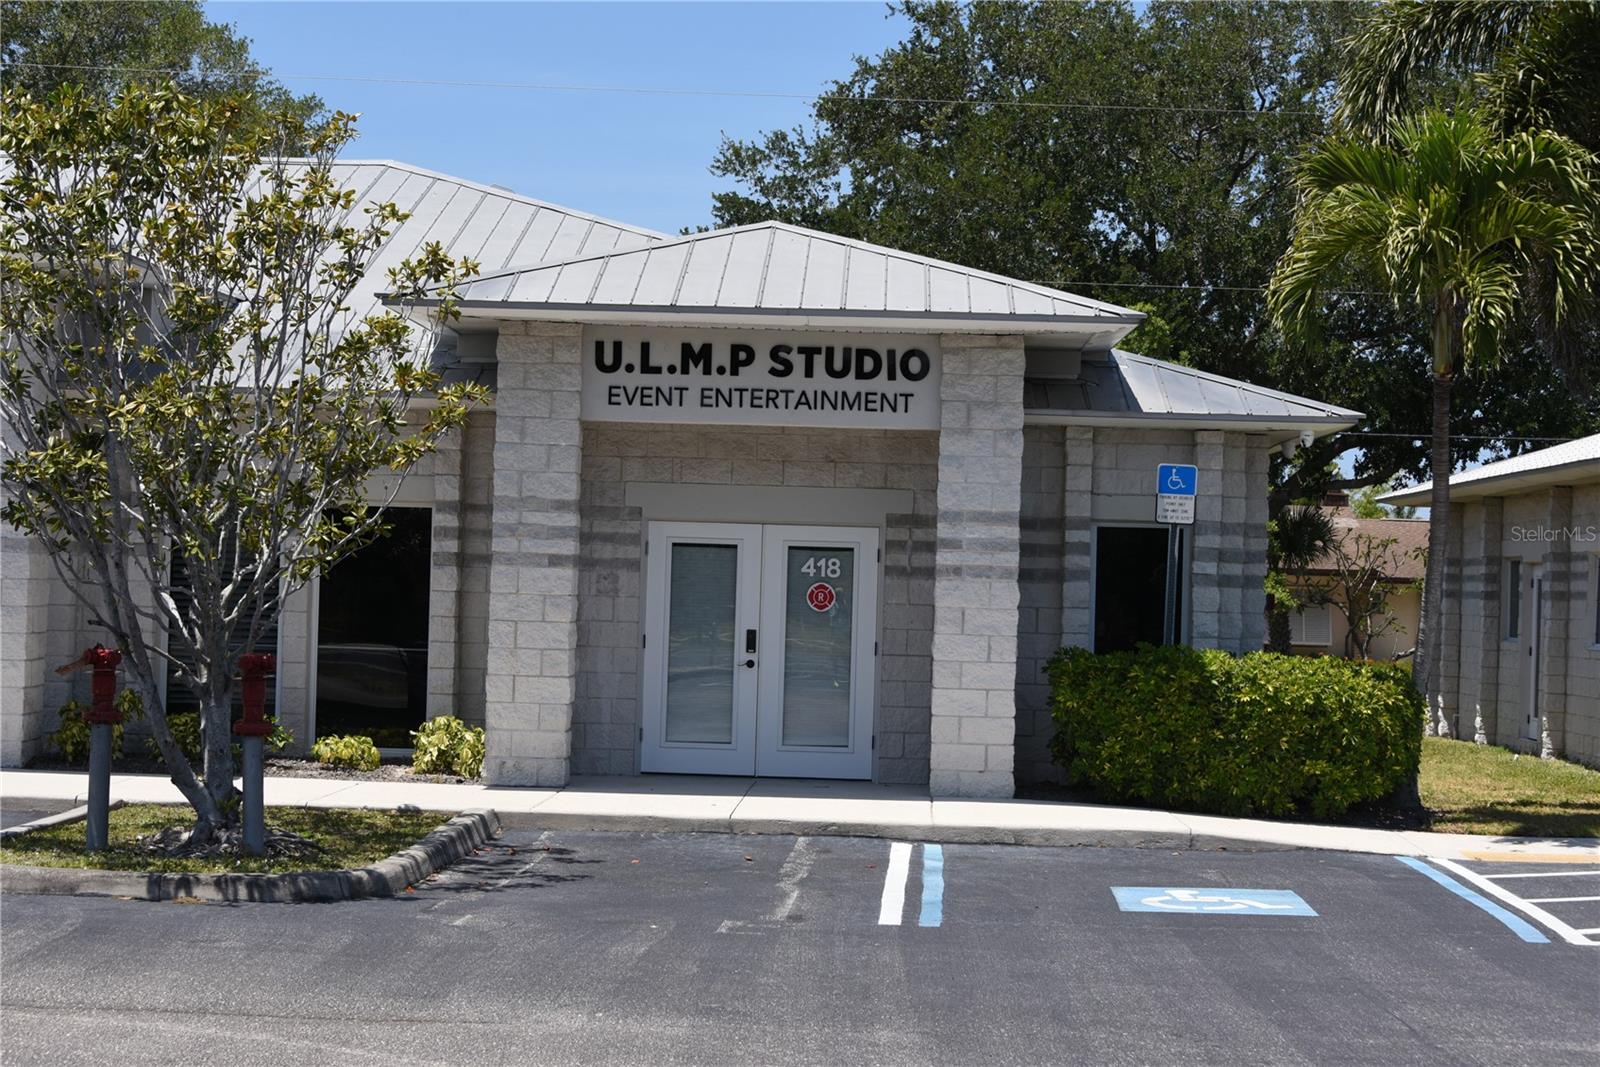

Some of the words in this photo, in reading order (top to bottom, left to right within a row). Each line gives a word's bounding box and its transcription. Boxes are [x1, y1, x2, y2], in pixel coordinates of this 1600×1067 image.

[594, 340, 756, 377] U.L.M.P
[768, 343, 931, 383] STUDIO
[607, 385, 689, 408] EVENT
[699, 387, 915, 414] ENTERTAINMENT
[801, 557, 841, 578] 418
[818, 592, 824, 602] R
